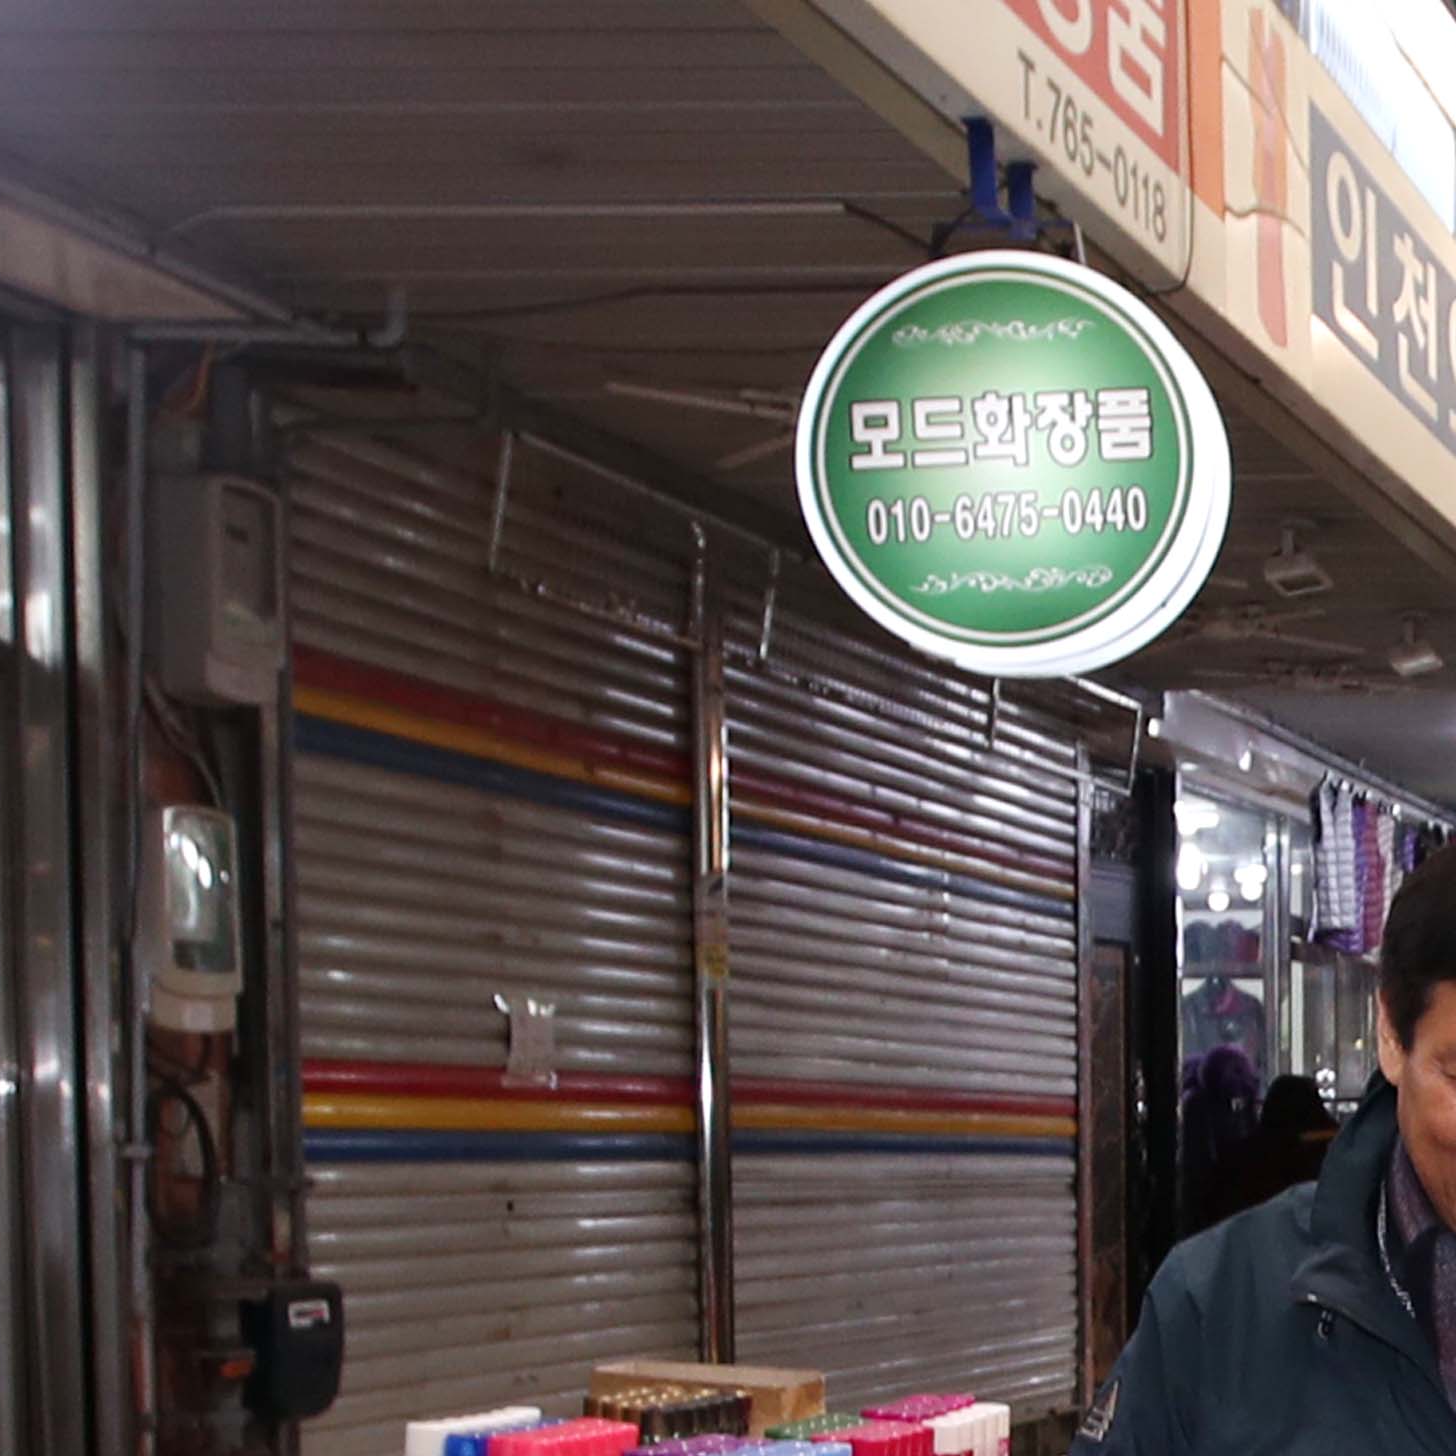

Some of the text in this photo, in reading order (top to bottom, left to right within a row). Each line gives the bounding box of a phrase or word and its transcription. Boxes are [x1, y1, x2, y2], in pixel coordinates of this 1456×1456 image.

[1017, 48, 1167, 244] T.765-0118
[848, 387, 1152, 472] 모드화장품
[866, 486, 1149, 546] 010-6475-0440
